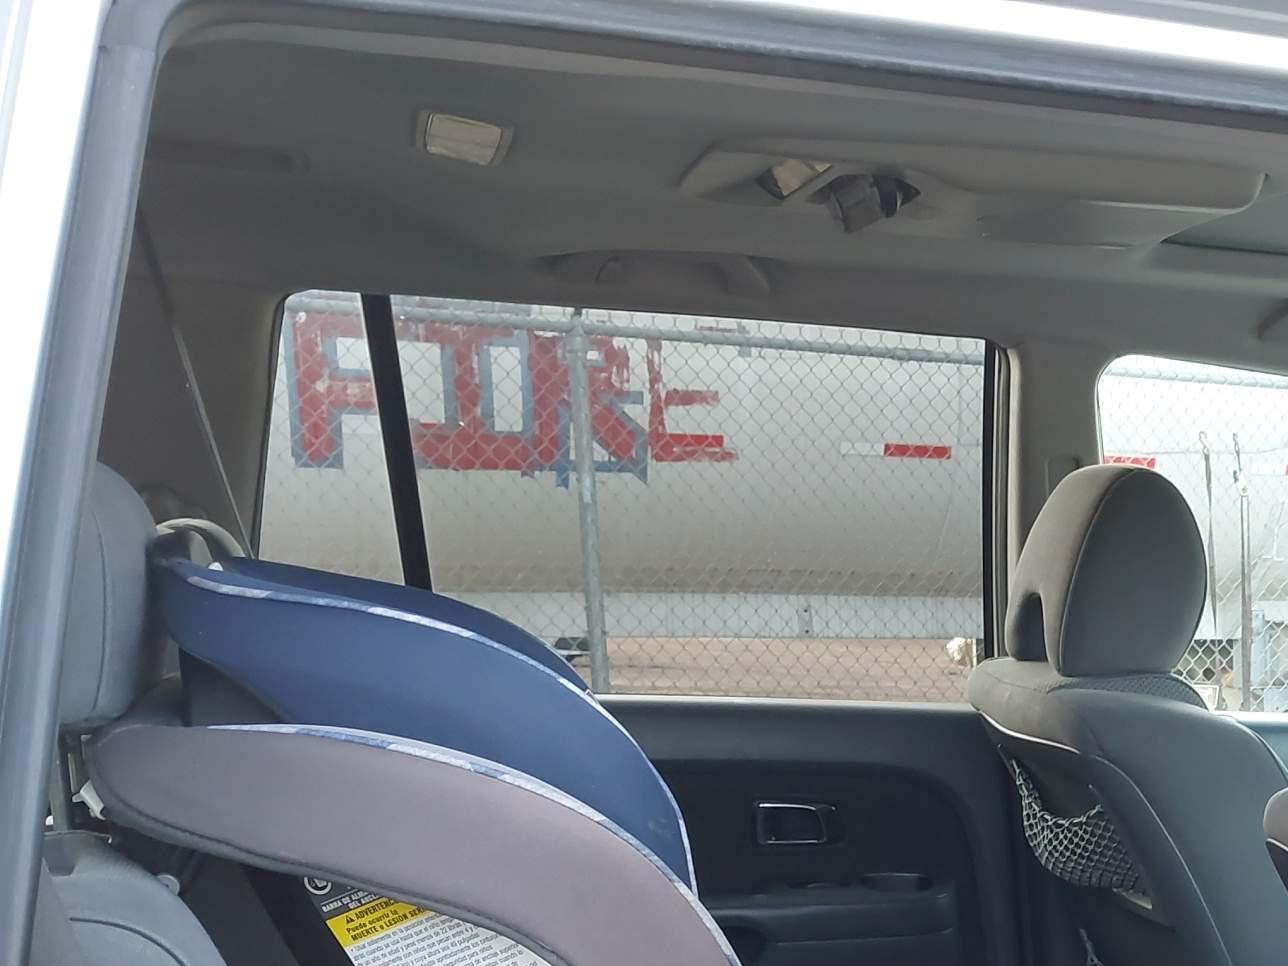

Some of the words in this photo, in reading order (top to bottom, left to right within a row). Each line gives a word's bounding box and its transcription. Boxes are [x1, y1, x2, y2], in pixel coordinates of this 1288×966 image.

[345, 920, 368, 934] Puede
[366, 911, 390, 925] ocurrir
[349, 924, 379, 941] MUERTE
